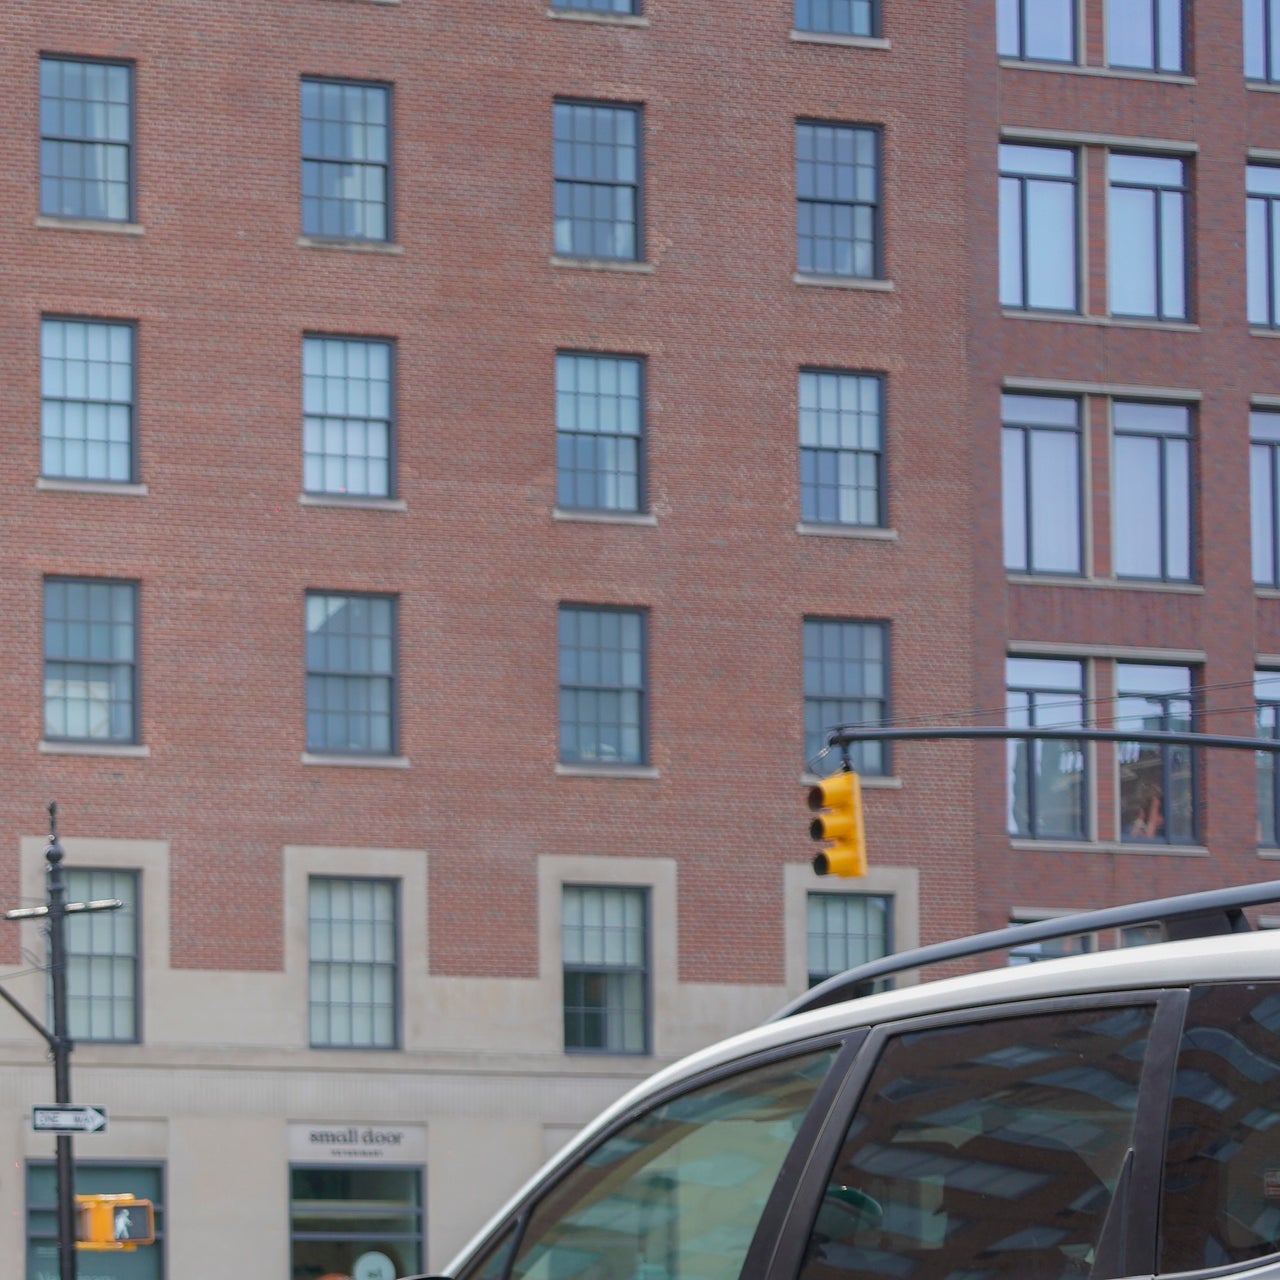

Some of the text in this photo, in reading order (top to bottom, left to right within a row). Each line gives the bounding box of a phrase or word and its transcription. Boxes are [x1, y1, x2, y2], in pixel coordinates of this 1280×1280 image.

[39, 1111, 96, 1125] ONE WAY
[309, 1128, 404, 1145] small door
